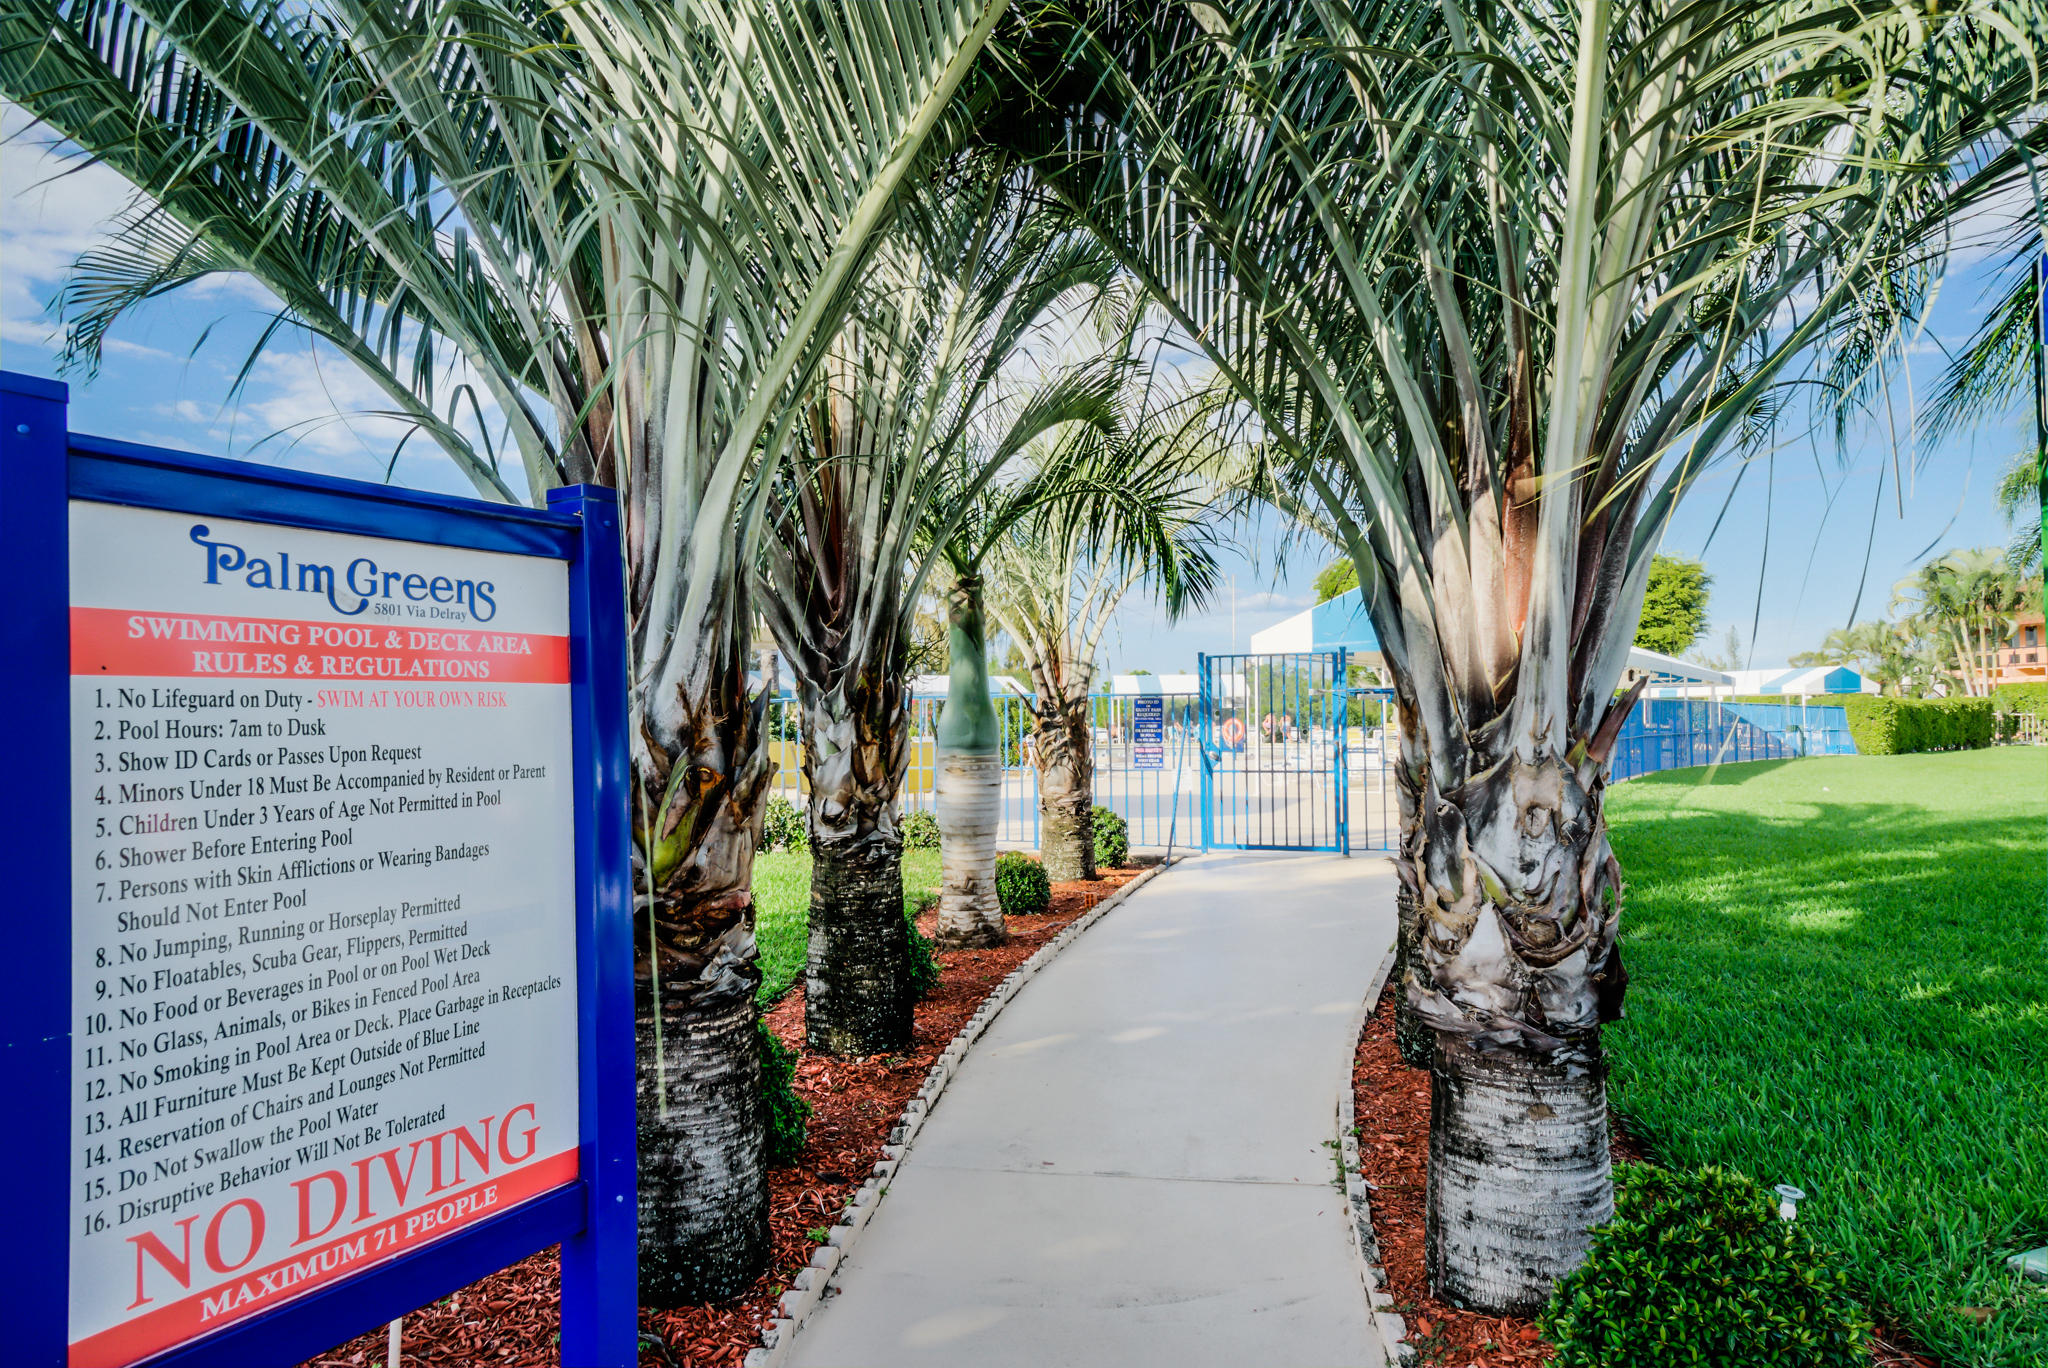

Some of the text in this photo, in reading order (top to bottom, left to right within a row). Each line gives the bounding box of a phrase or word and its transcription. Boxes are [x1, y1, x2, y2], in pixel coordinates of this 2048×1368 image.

[189, 524, 497, 623] Palm Greens
[128, 616, 531, 654] SWIMMING POOL & DECK AREA
[373, 603, 468, 622] 5801 Via Delray
[192, 651, 489, 678] RULES & REGULATIONS
[118, 688, 508, 713] No Lifeguard on Duty SWIM AT YOUR OWN RISK
[118, 718, 326, 739] Pool Hours: 7am to Dusk
[119, 745, 421, 772] Show ID Cards or Passes Upon Request
[119, 764, 545, 803] Minors Under 18 Must Be Accompanied by Resident or Parent
[119, 790, 500, 835] Children Under 3 Years of Age Not Permitted in Pool
[120, 827, 352, 868] Shower Before Entering Pool
[120, 842, 489, 900] Persons with Skin Afflictions or Wearing Bandages
[118, 888, 306, 932] Should Not Enter Pool
[119, 894, 460, 964] No Jumping, Running or Horseplay Permitted
[120, 920, 467, 997] No Floatables, Scuba Gear, Flippers, Permitted
[120, 940, 490, 1029] No Food or Beverages in Pool or on Pool Wet Deck
[119, 975, 560, 1094] No Smoking in Pool Area or Deck. Place Garbage in Receptacles
[120, 971, 480, 1061] No Glass, Animals, or Bikes in Fenced Pool Area
[119, 1020, 479, 1126] All Furniture Must Be Kept Outside of Blue Line
[119, 1041, 485, 1159] Reservation of Chairs and Lounges Not Permitted
[119, 1102, 378, 1192] Do Not Swallow the Pool Water
[119, 1104, 445, 1225] Disruptive Behavior Will Not Be Tolerated
[126, 1103, 540, 1310] NO DIVING
[200, 1184, 497, 1322] MAXIMUM 71 PEOPLE
